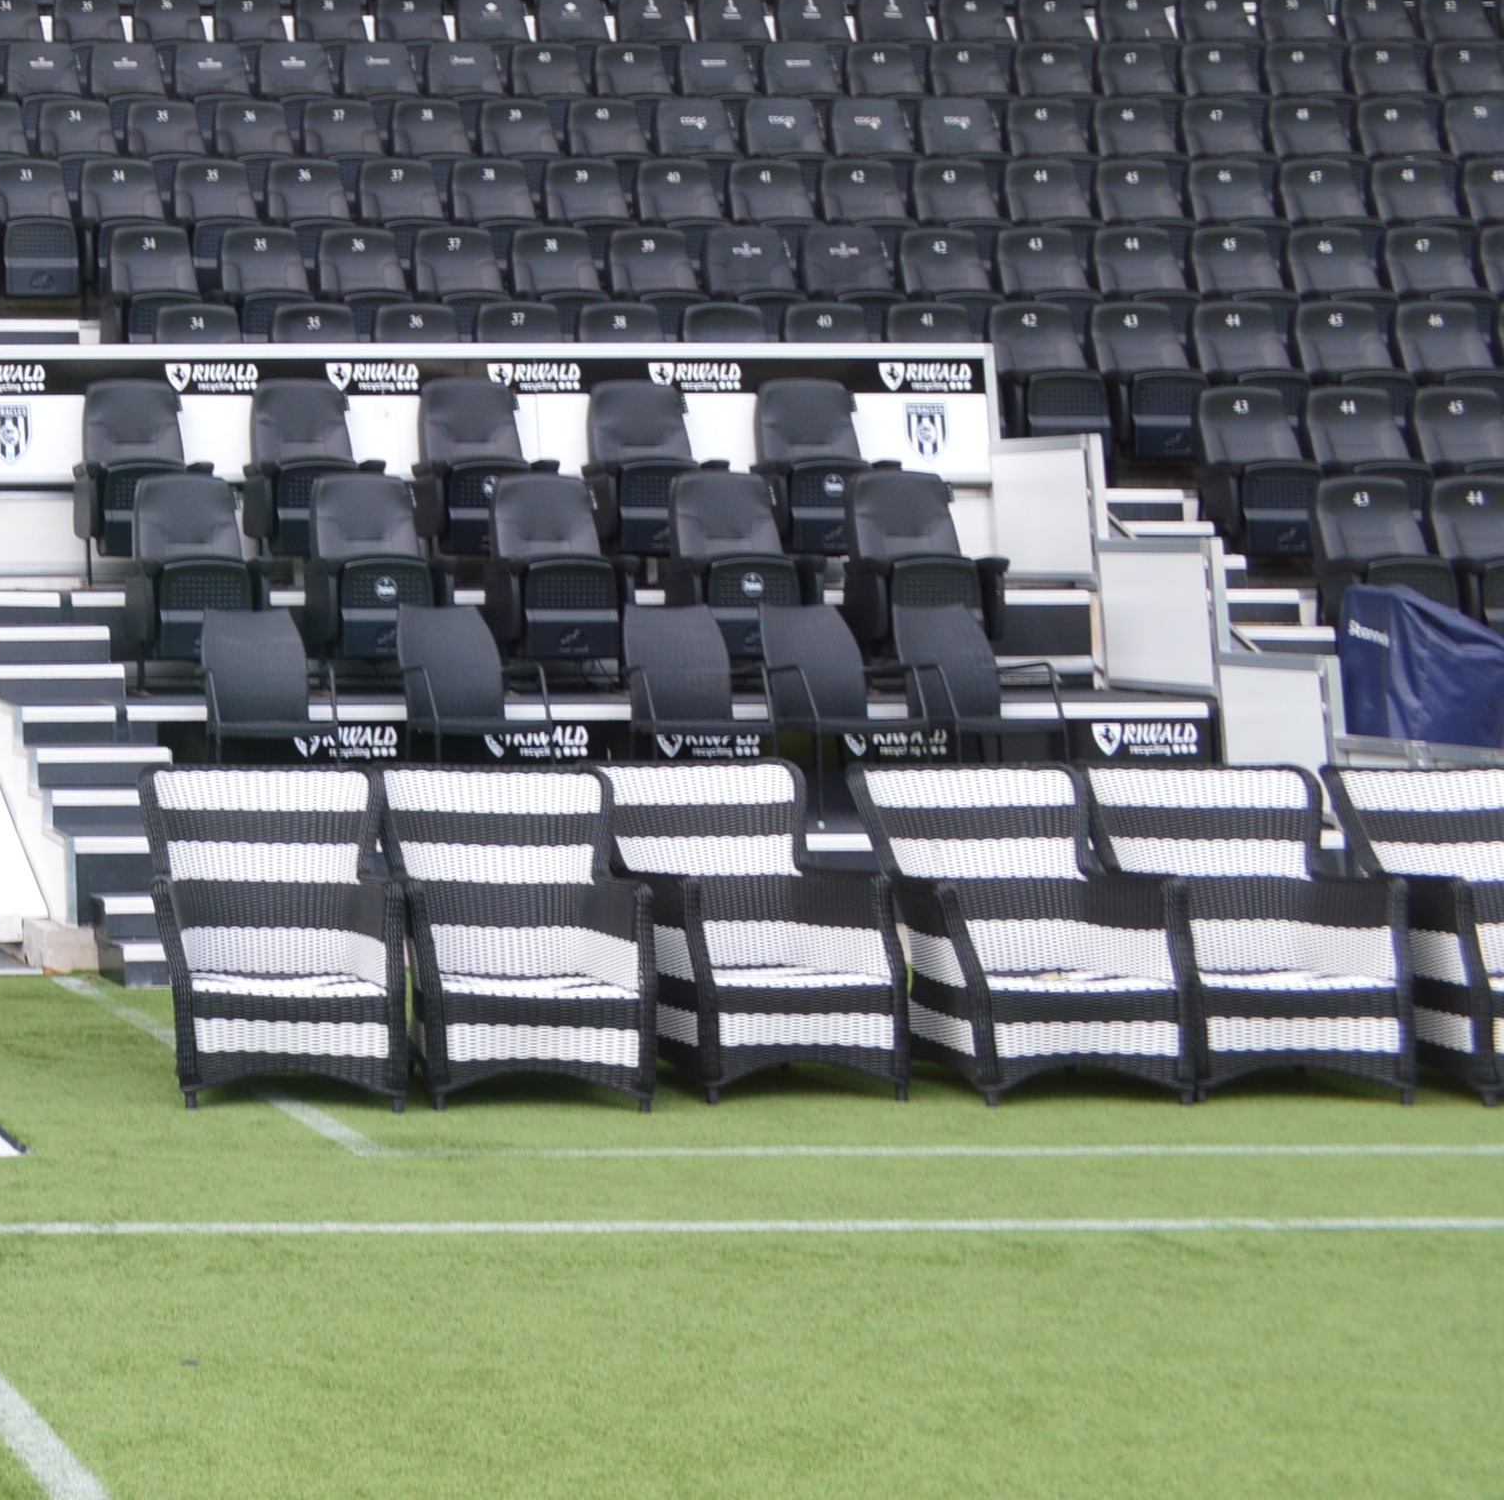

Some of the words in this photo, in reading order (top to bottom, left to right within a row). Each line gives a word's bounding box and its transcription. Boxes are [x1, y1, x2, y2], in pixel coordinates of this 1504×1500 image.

[142, 237, 156, 251] 34
[351, 238, 366, 252] 36
[544, 238, 558, 252] 38
[932, 240, 947, 254] 42
[1124, 237, 1140, 250] 44
[1317, 240, 1333, 254] 46
[190, 316, 205, 330] 34
[306, 316, 321, 331] 35
[510, 312, 526, 326] 37
[816, 314, 833, 328] 40
[1021, 313, 1037, 328] 42
[1225, 313, 1241, 327] 44
[192, 363, 258, 382] RIWALD
[352, 363, 418, 382] RIWALD
[514, 363, 580, 382] RIWALD
[675, 363, 741, 382] RIWALD
[905, 362, 971, 381] RIWALD
[197, 381, 234, 392] recycling
[357, 381, 394, 392] recycling
[519, 381, 556, 392] recycling
[680, 381, 717, 392] recycling
[910, 380, 947, 391] recycling
[1232, 399, 1249, 414] 43
[1339, 400, 1356, 414] 44
[1447, 399, 1464, 415] 45
[1352, 491, 1370, 507] 43
[1466, 490, 1484, 506] 44
[1123, 723, 1197, 743] RIWALD
[1129, 744, 1170, 756] recycling
